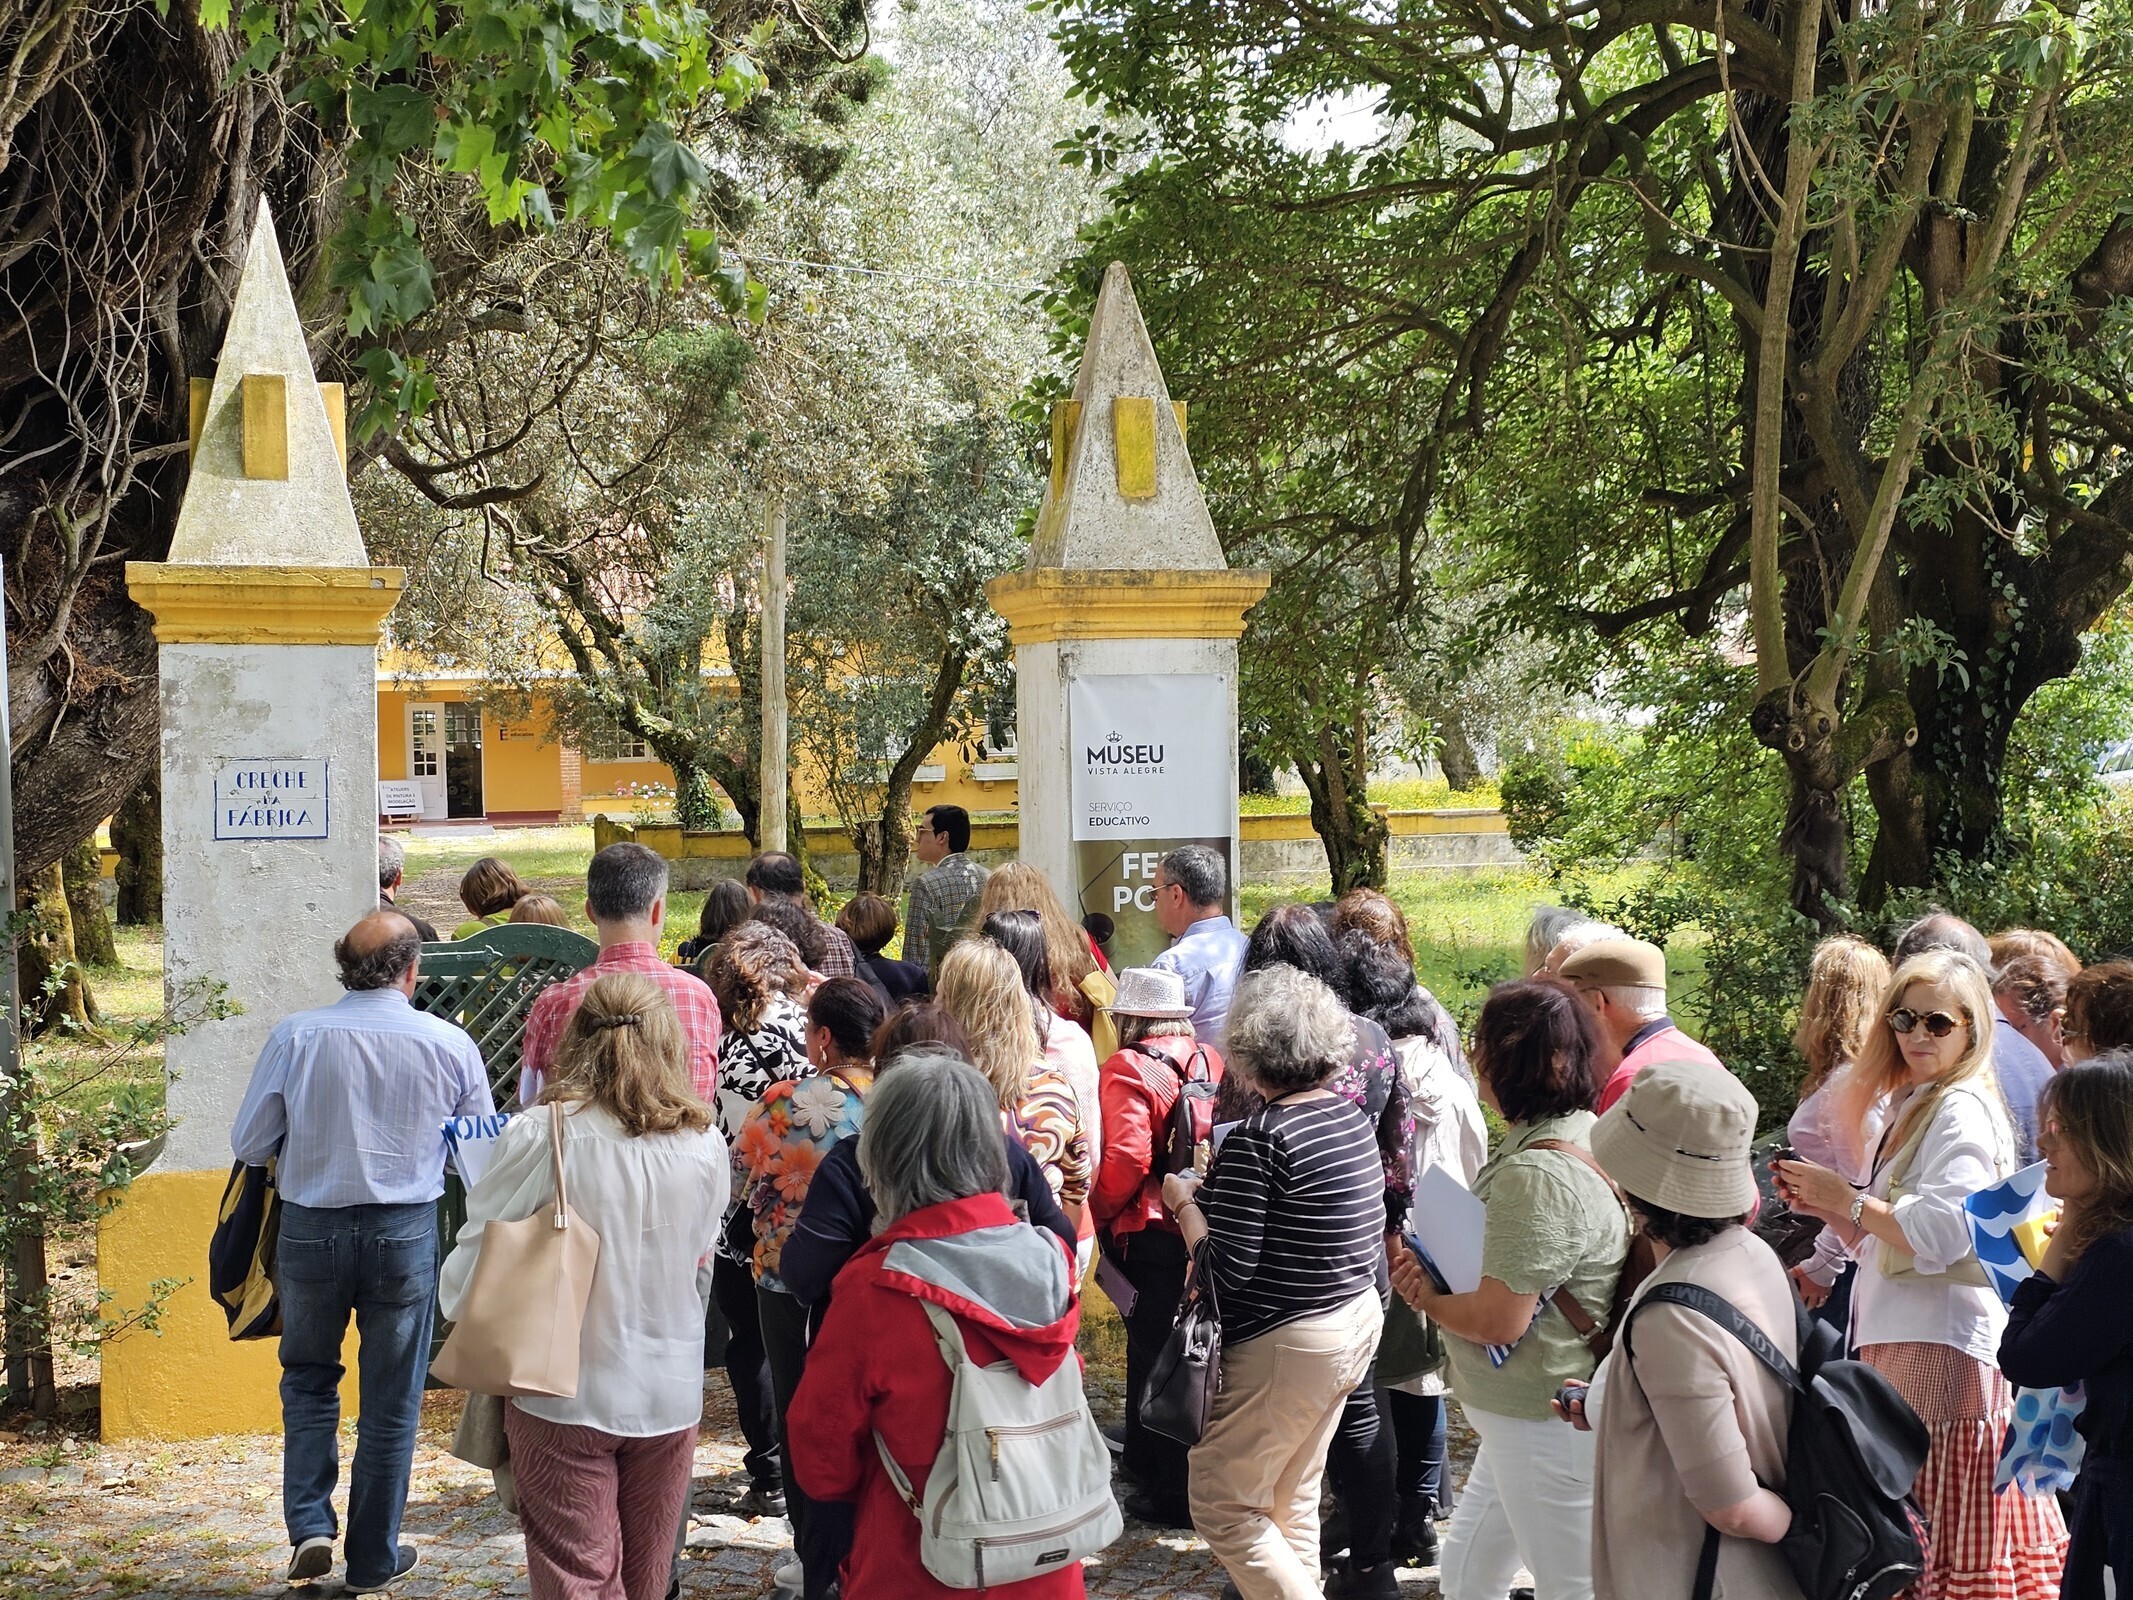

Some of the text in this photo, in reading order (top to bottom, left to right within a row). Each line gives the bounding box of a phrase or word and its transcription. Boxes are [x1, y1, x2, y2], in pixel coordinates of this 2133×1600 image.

[1087, 744, 1164, 765] MUSEU
[236, 771, 308, 789] CRECHE
[1087, 766, 1165, 776] VISTA ALEGRE
[228, 805, 313, 827] FÁBRICA
[1088, 801, 1133, 815] SERVIÇO
[1089, 815, 1150, 827] EDUCATIVO
[1122, 851, 1168, 879] FE
[1731, 1310, 1776, 1362] LOLA
